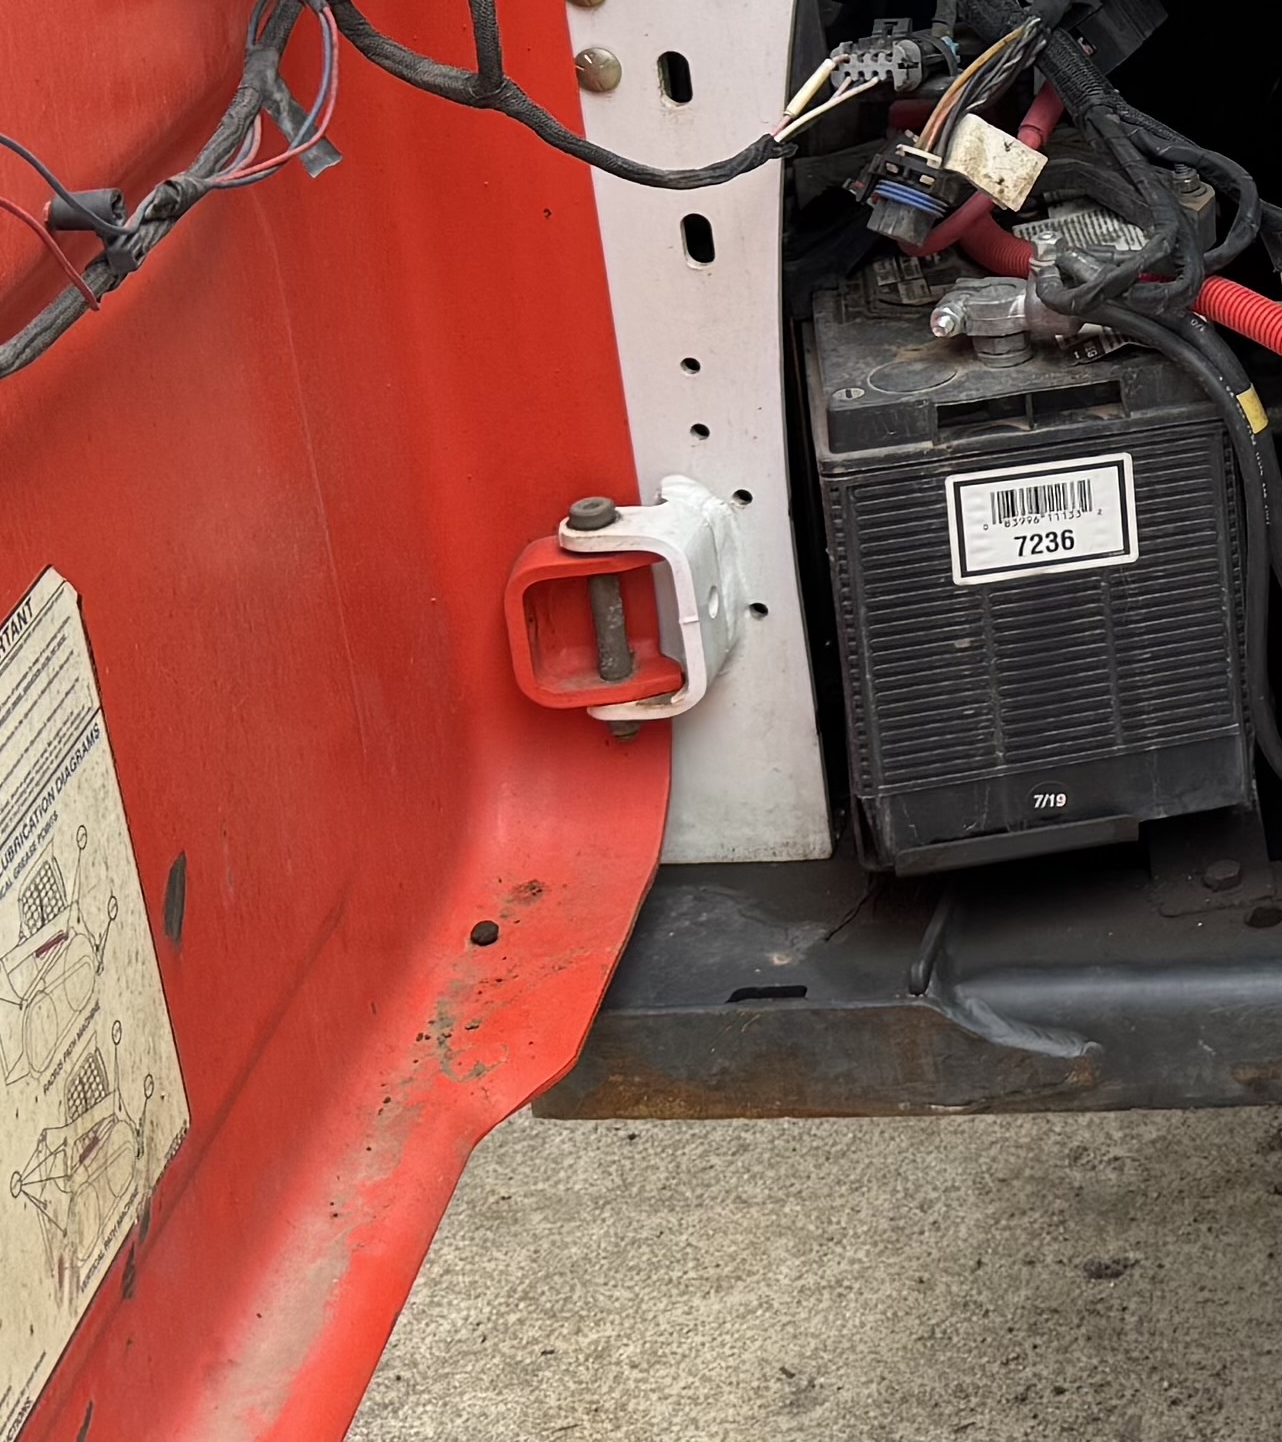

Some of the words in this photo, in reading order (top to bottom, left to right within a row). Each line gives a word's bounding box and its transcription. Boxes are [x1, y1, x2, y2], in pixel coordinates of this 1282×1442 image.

[1014, 529, 1075, 557] 7236
[54, 722, 101, 796] DIAGRAMS
[1032, 792, 1067, 810] 7/19
